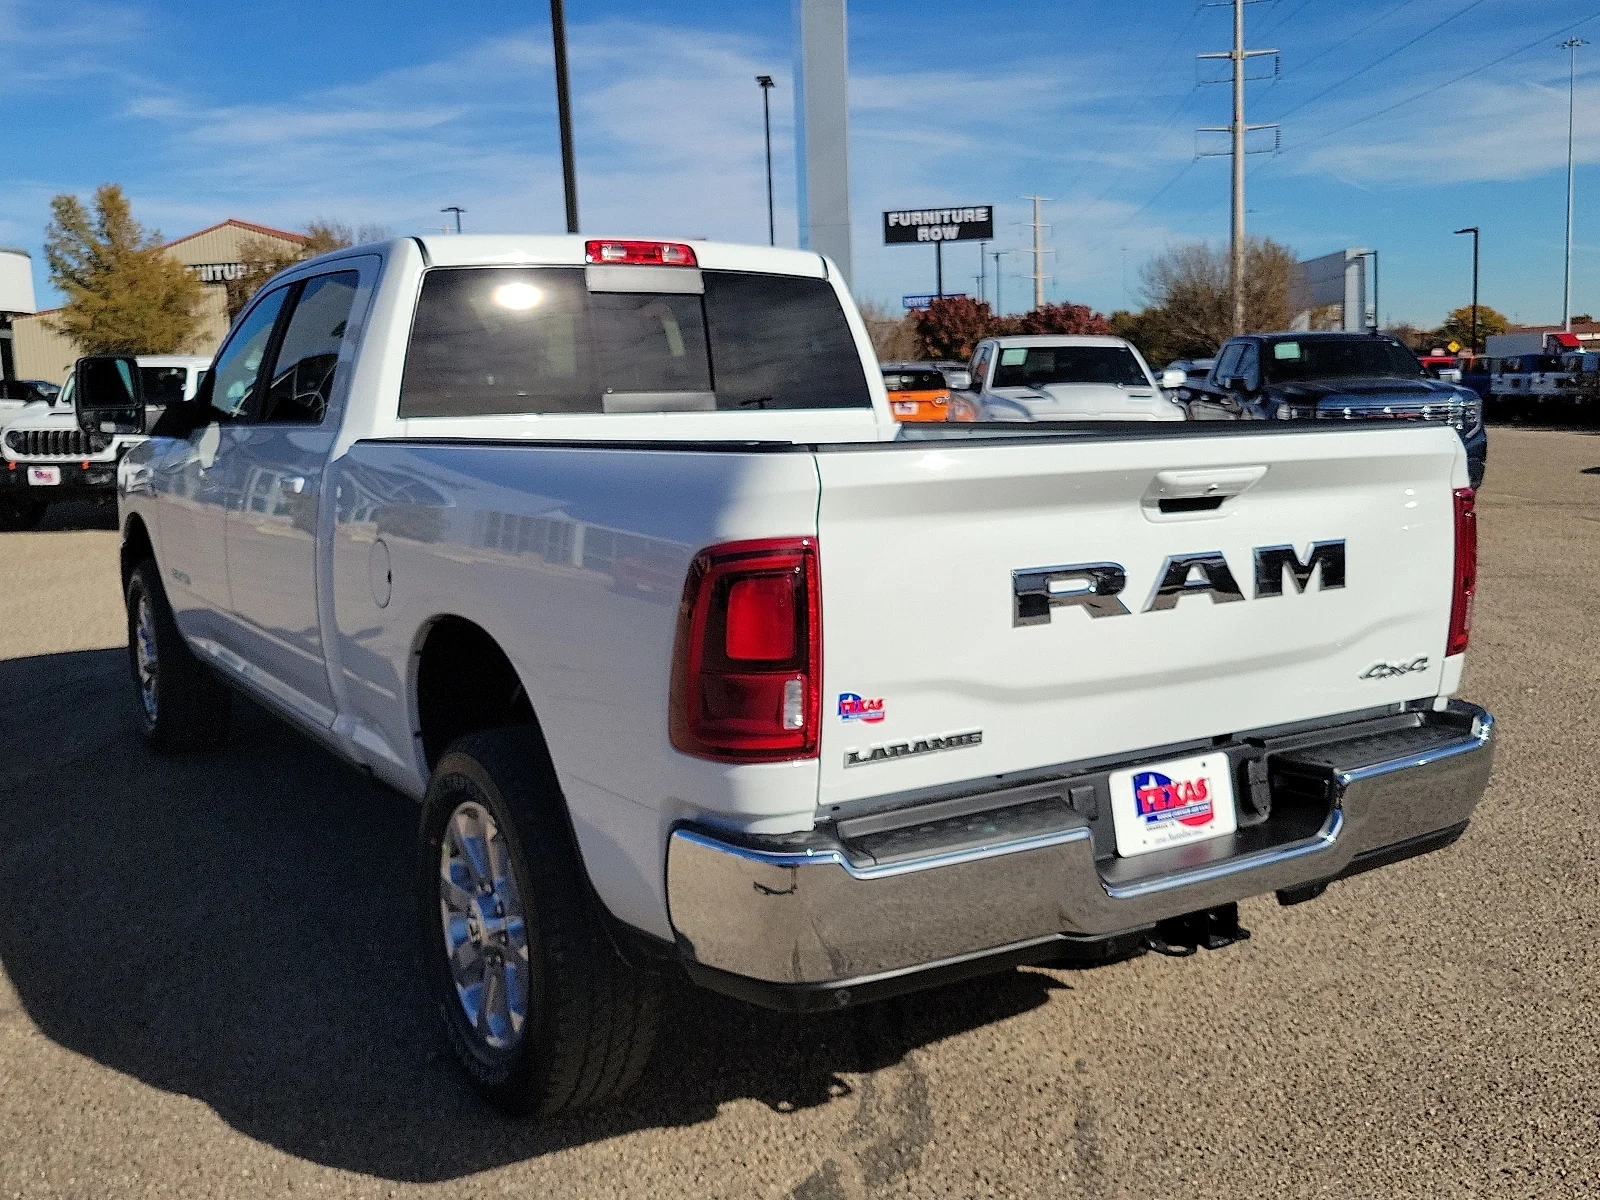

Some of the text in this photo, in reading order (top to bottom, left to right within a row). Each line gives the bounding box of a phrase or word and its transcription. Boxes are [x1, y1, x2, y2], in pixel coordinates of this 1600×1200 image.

[888, 207, 989, 226] FURNITURE
[917, 224, 960, 241] ROW
[1012, 538, 1347, 628] RAM
[843, 730, 983, 769] LARAMIE
[1137, 777, 1208, 814] TEXAS
